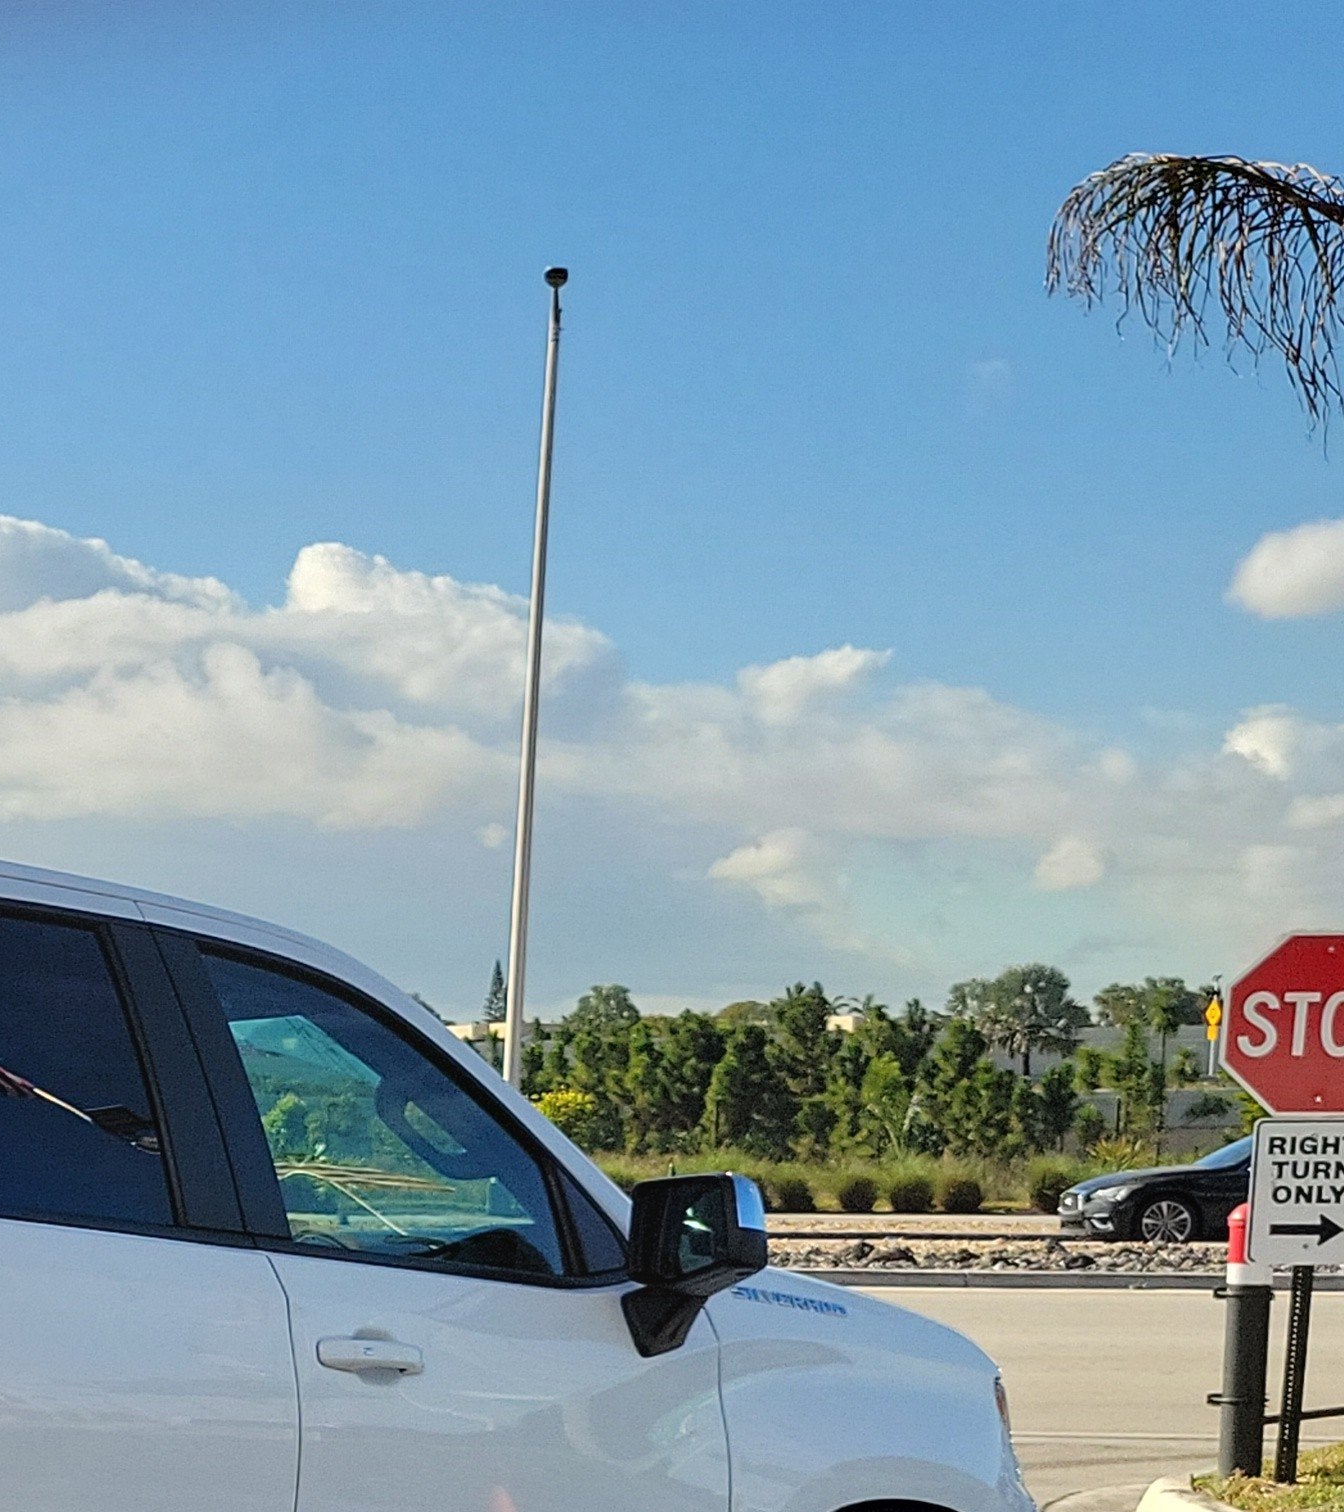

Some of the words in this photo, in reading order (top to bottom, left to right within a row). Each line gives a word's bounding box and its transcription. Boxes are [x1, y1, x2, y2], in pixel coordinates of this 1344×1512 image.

[1268, 1135, 1344, 1155] RIGH
[1272, 1160, 1344, 1179] TURN
[1272, 1185, 1344, 1204] ONLY
